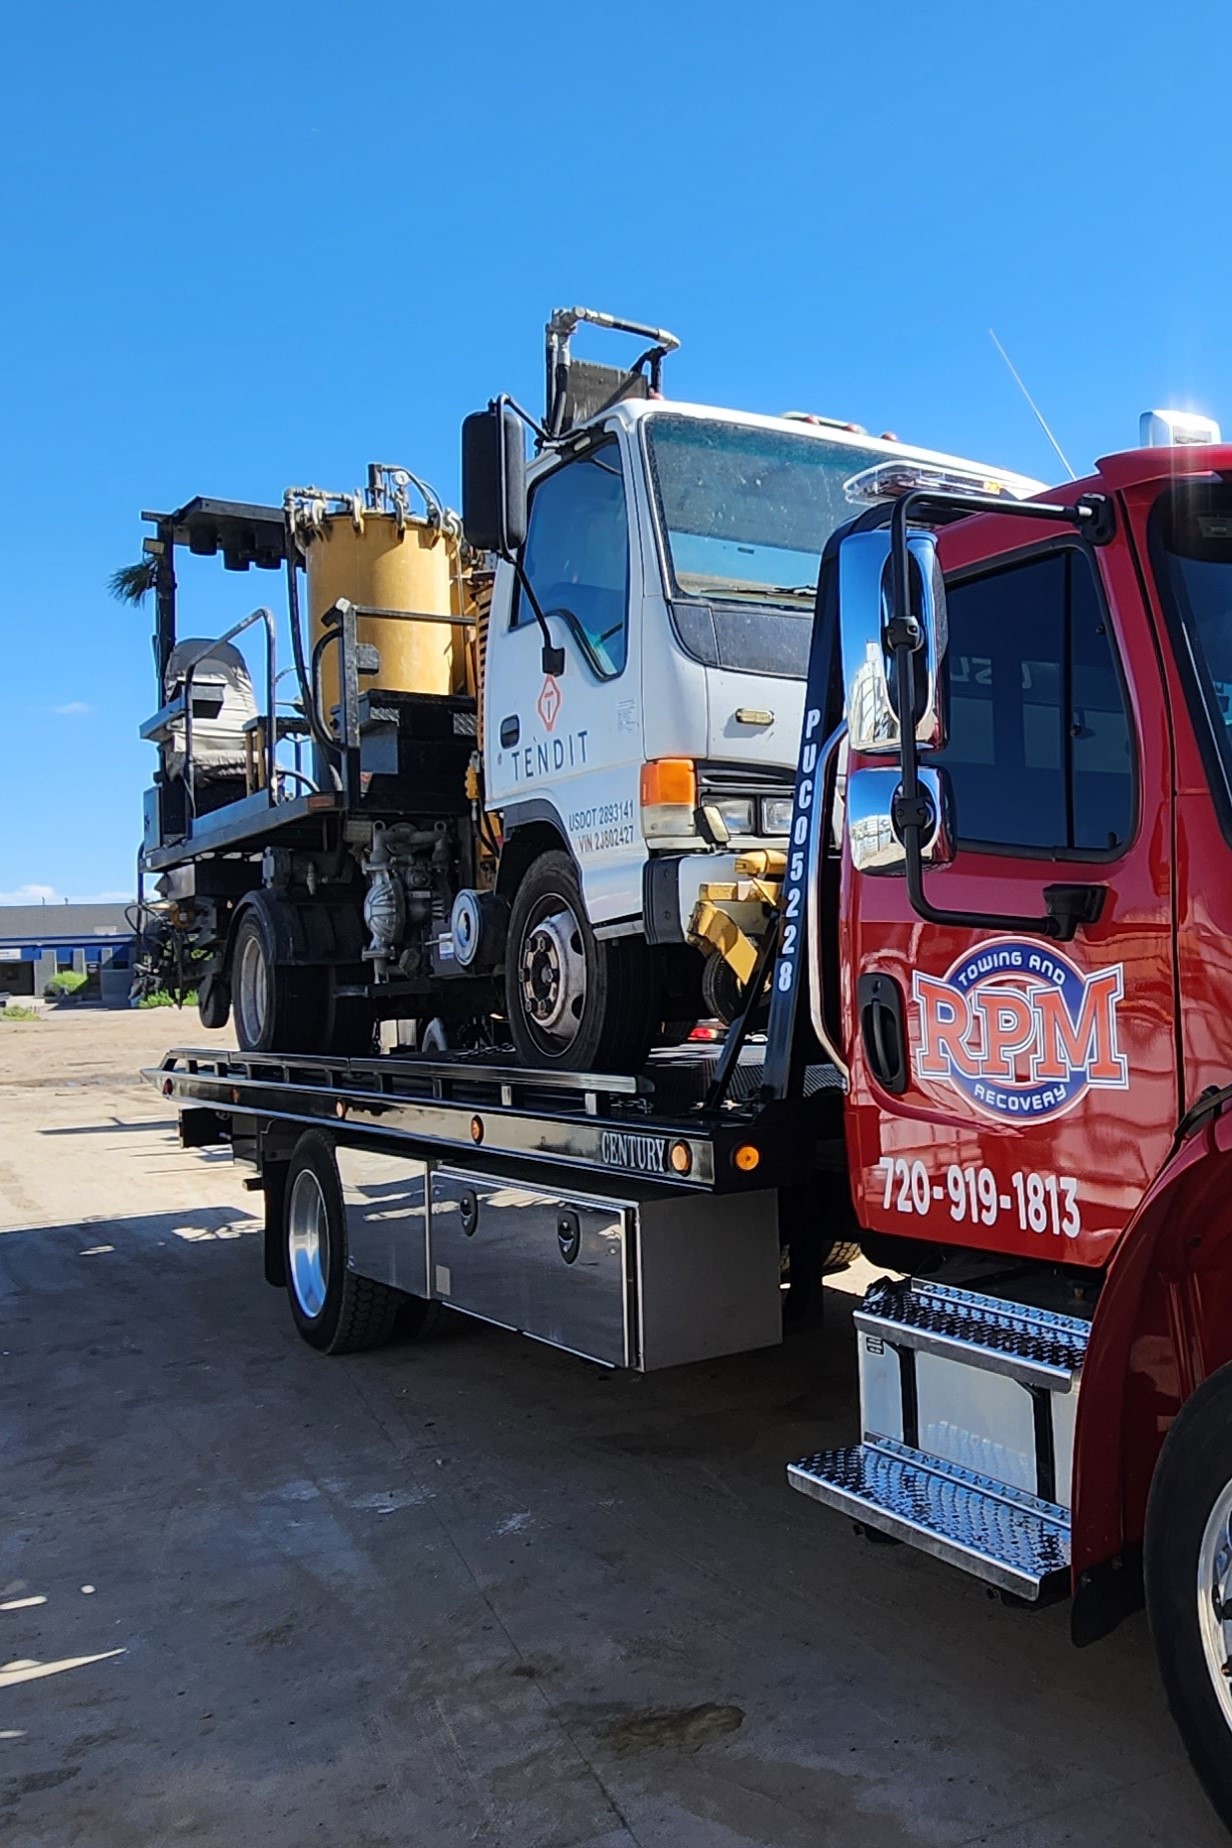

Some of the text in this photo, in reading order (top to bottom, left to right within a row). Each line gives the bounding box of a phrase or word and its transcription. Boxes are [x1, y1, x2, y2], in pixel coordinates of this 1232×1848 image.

[511, 731, 588, 781] TENDIT
[569, 799, 634, 832] USDOT 2893141
[577, 834, 593, 854] VIN
[958, 951, 1066, 987] TOWING AND
[912, 962, 1129, 1090] RPM
[973, 1083, 1067, 1111] RECOVERY
[601, 1131, 665, 1172] CENTURY
[879, 1157, 1082, 1239] 720-919-1813
